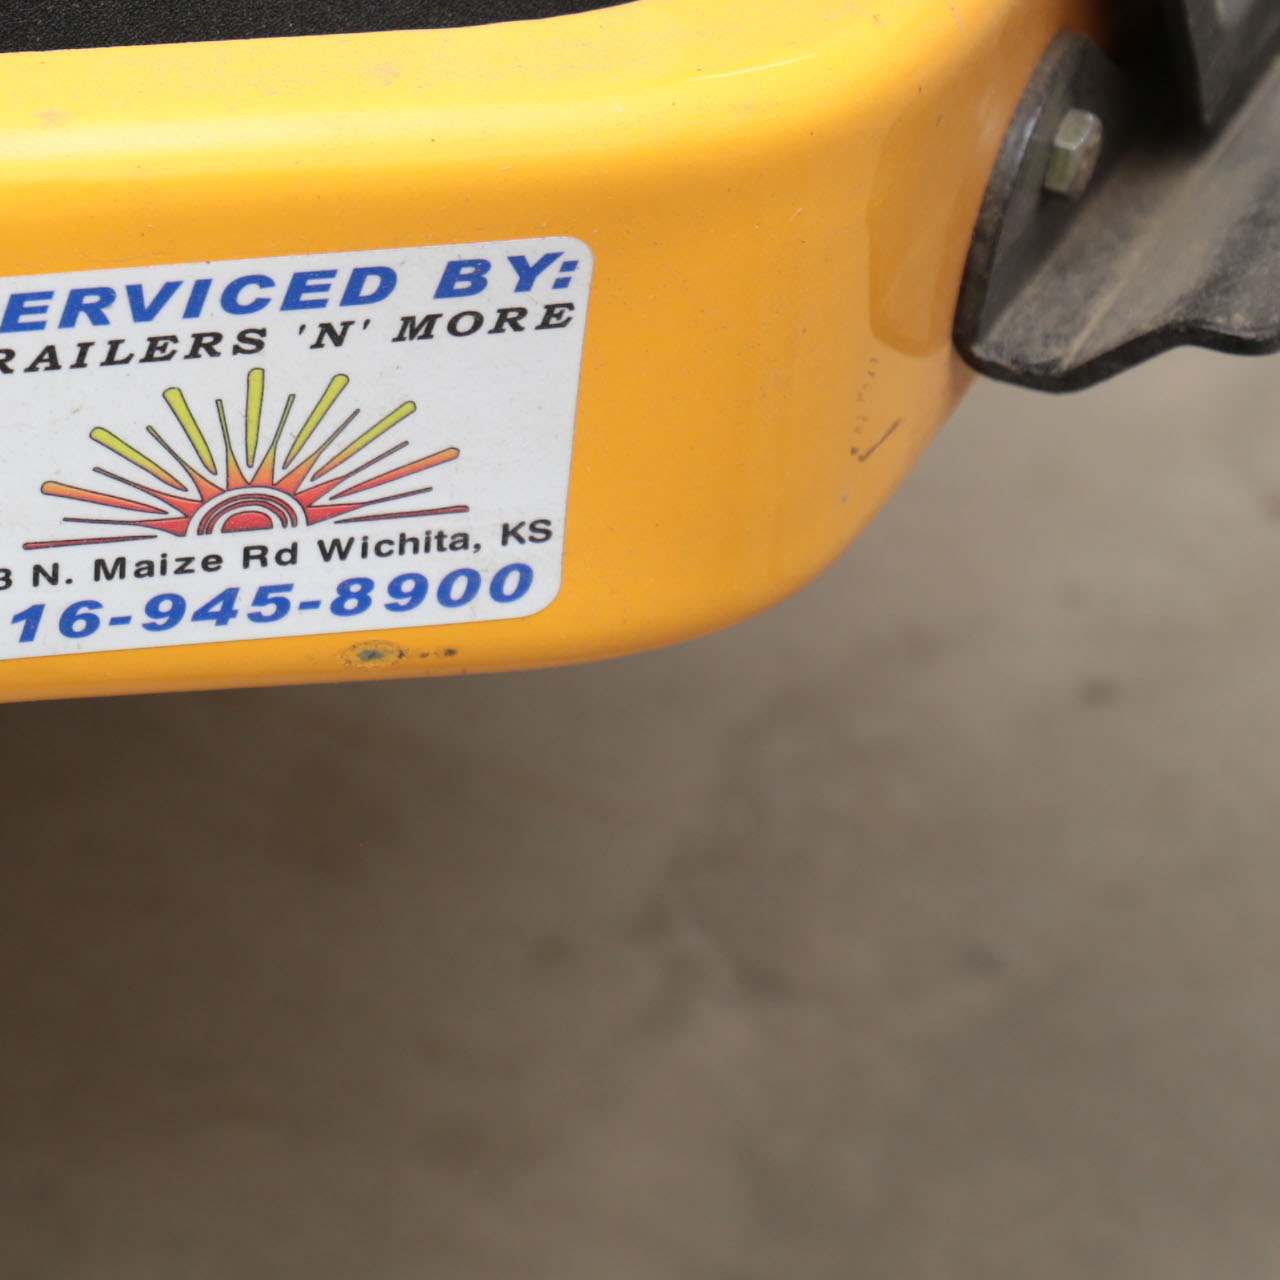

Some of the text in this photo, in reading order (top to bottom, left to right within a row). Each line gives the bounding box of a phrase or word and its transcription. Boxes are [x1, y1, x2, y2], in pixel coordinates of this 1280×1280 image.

[433, 252, 579, 300] BY:
[391, 302, 575, 343] MORE
[32, 562, 73, 588] N.
[93, 553, 223, 582] Maize
[242, 541, 298, 570] Rd
[317, 530, 481, 563] Wichita,
[501, 519, 552, 547] KS
